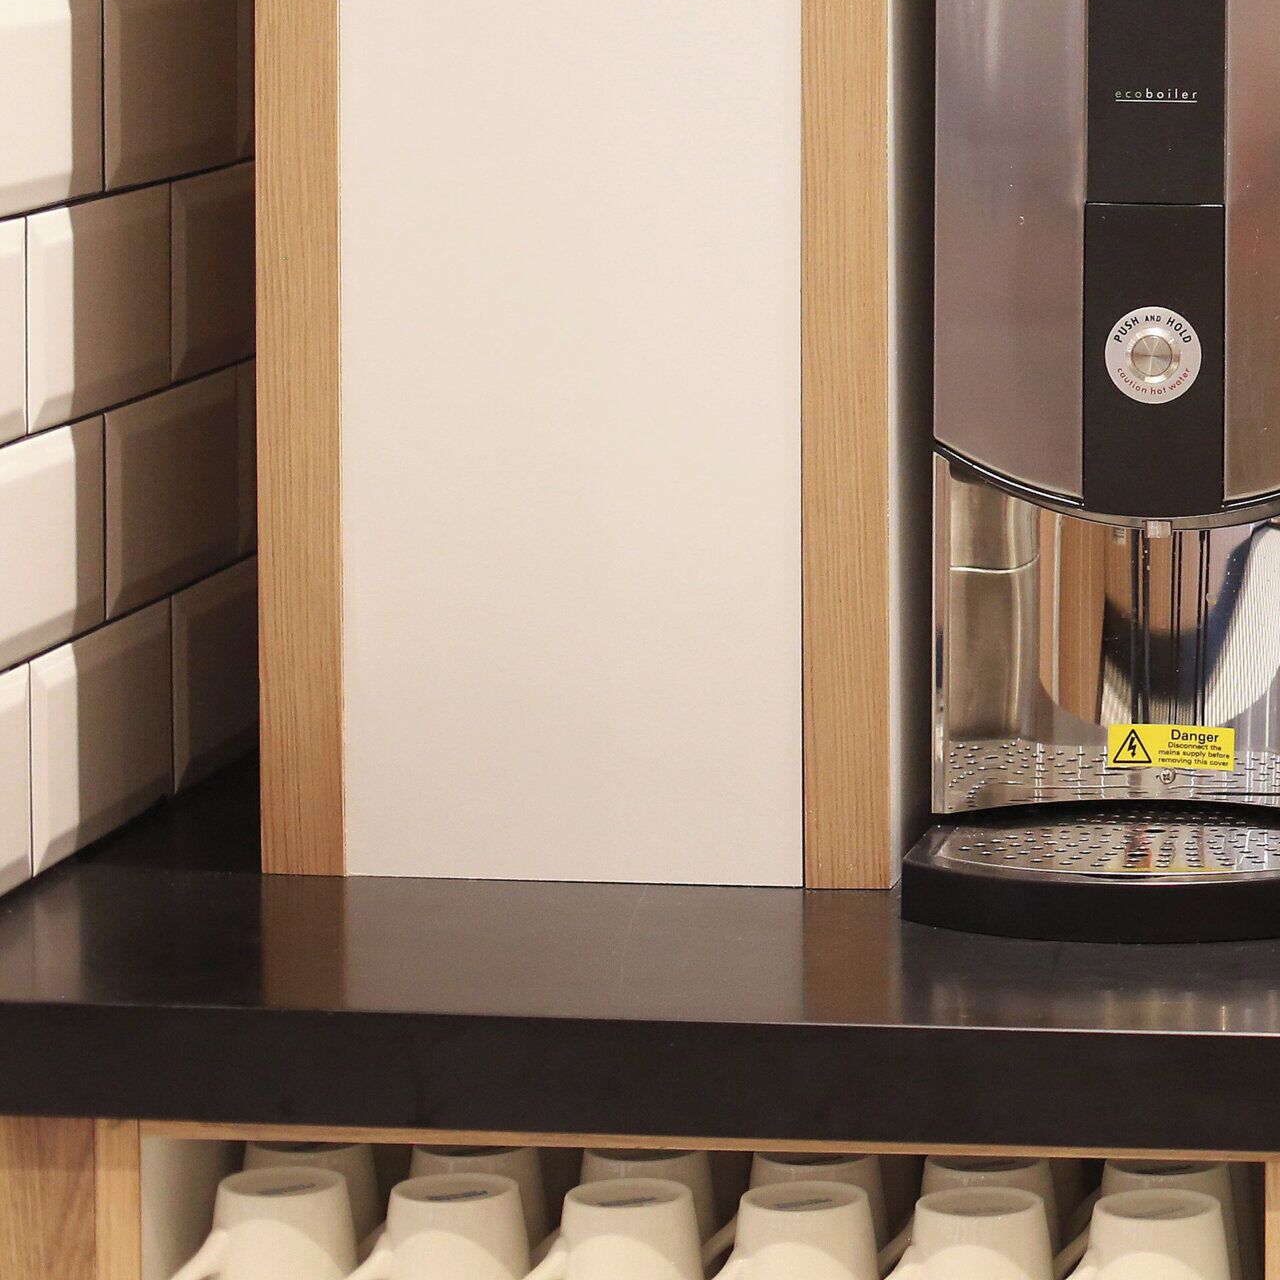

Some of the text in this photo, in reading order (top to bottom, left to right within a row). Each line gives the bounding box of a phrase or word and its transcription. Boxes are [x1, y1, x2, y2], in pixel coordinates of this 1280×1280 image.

[1115, 88, 1198, 99] ecoboiler
[1113, 316, 1140, 343] PUSH
[1166, 317, 1192, 344] HOLD
[1117, 368, 1190, 395] caution hot water
[1171, 729, 1219, 744] Danger
[1167, 741, 1208, 751] Disconnect
[1182, 750, 1206, 758] supply
[1158, 757, 1192, 765] removing
